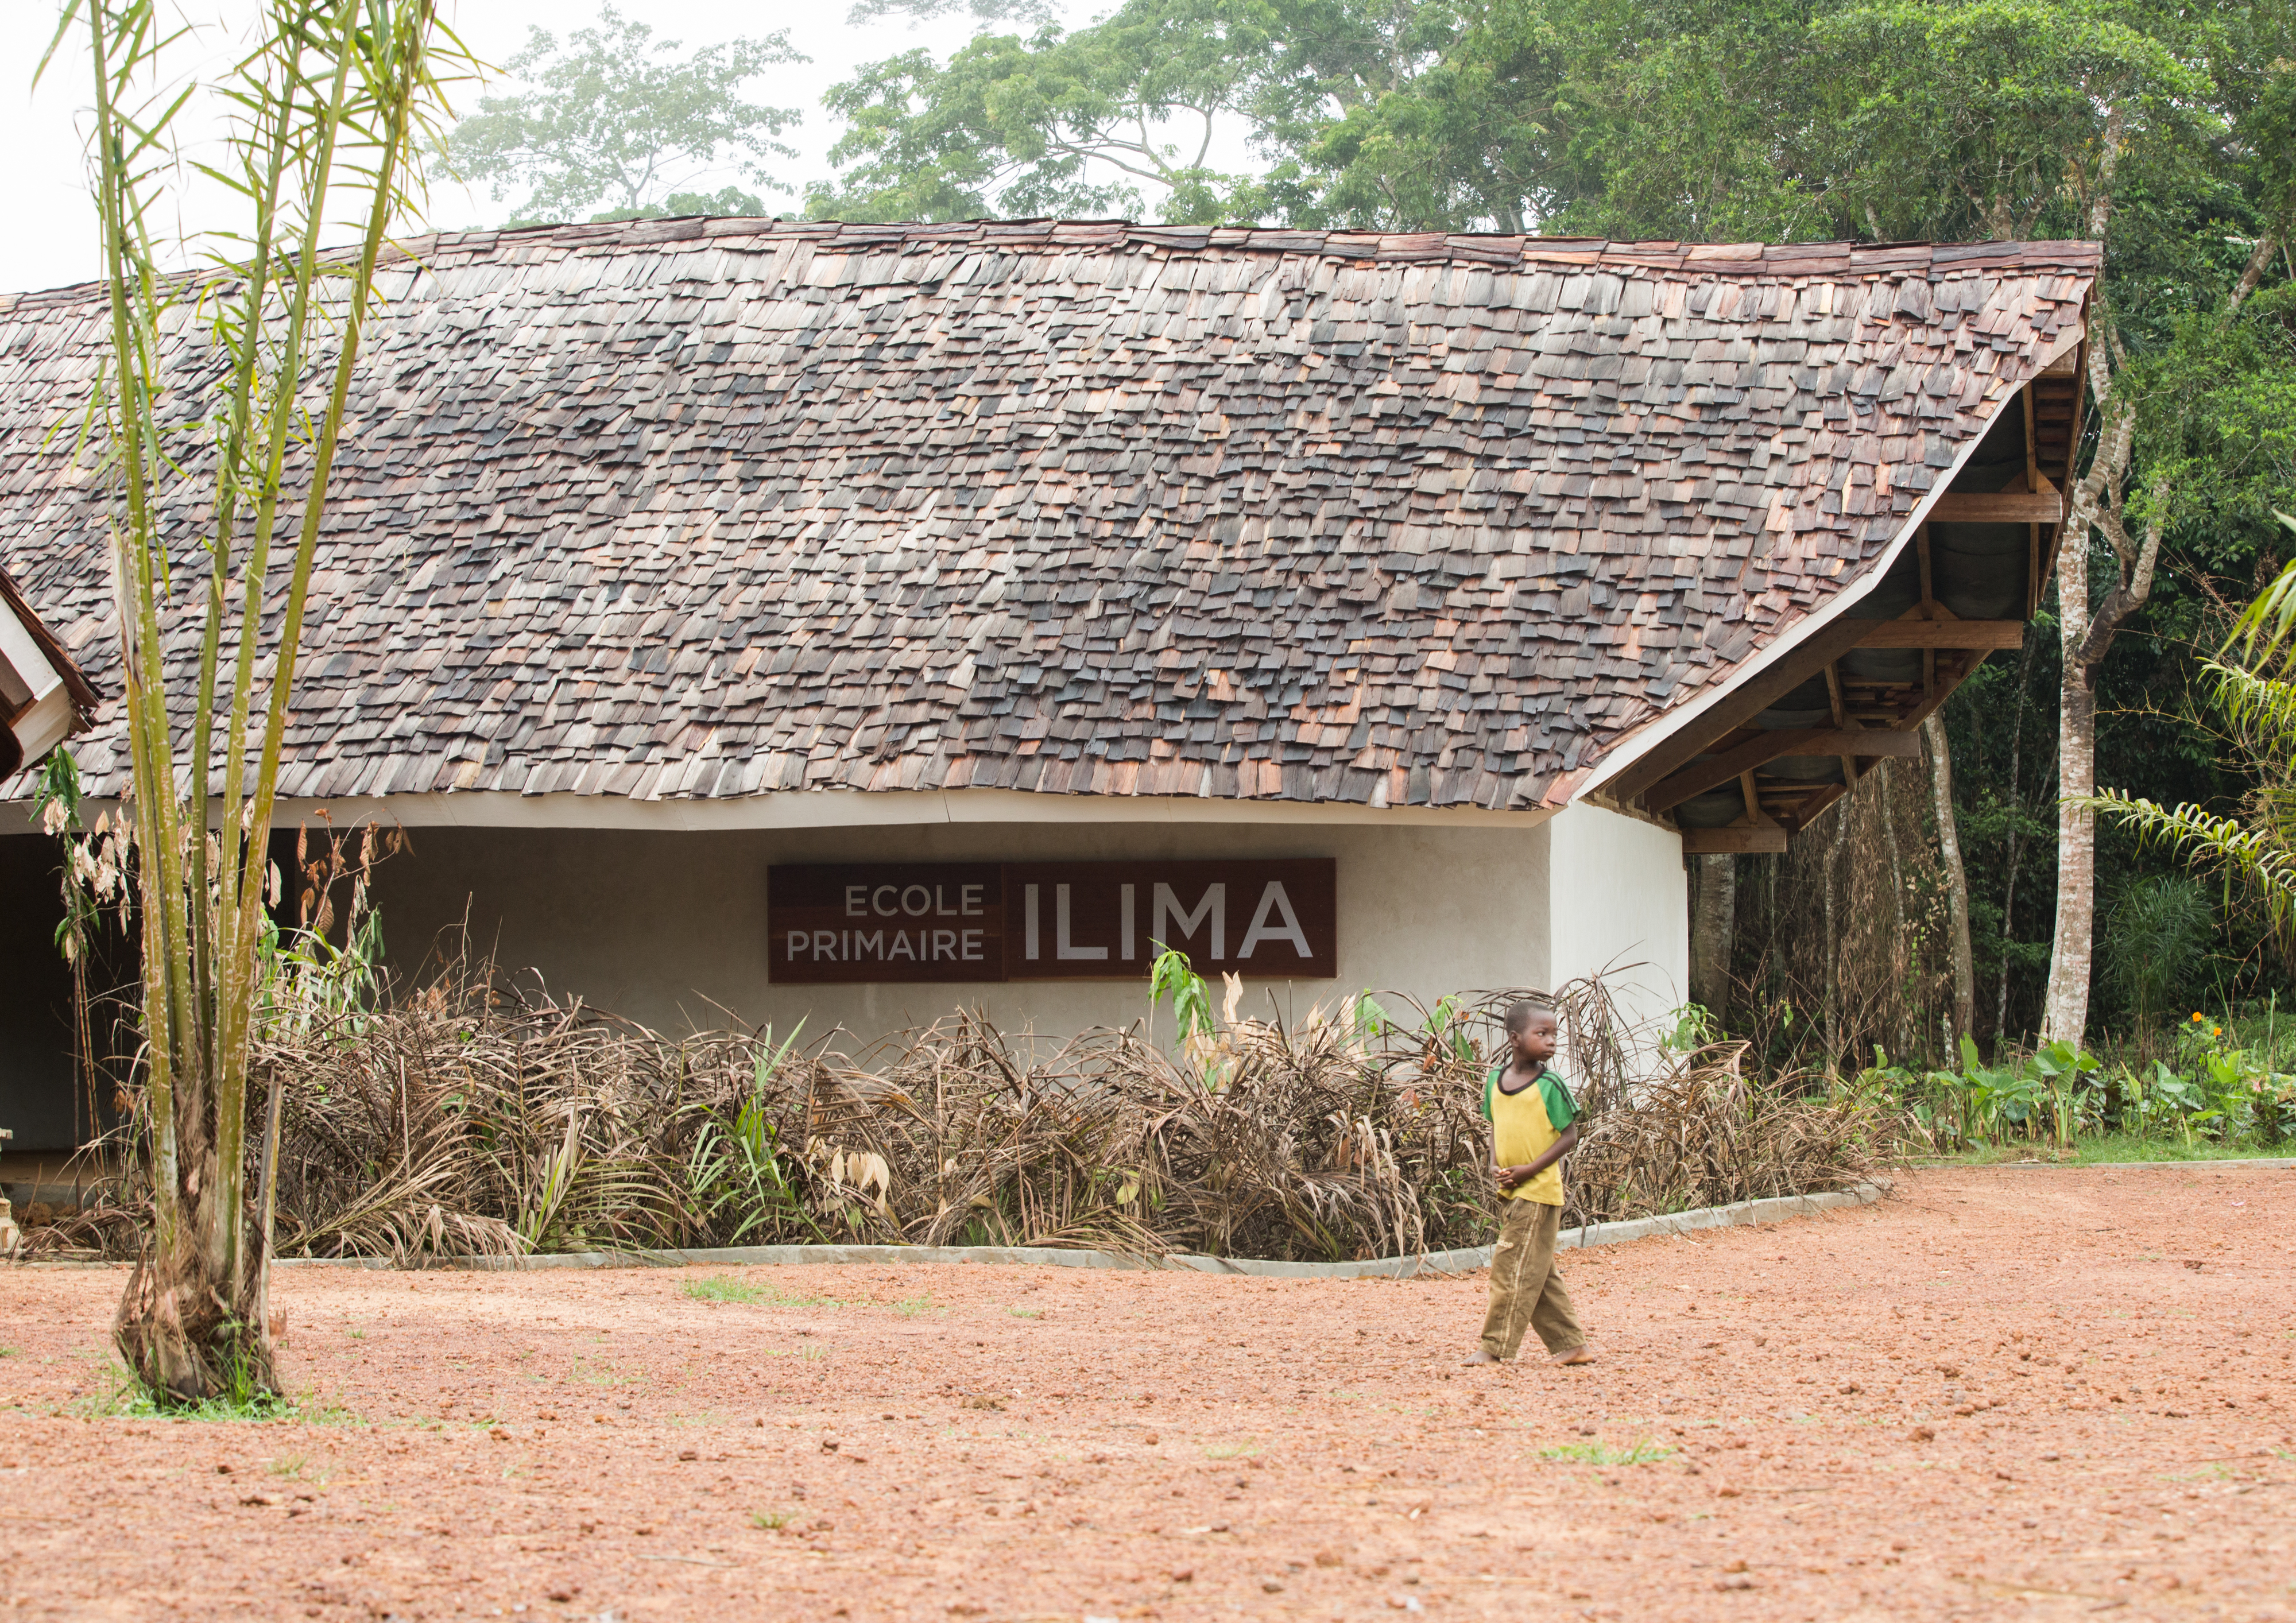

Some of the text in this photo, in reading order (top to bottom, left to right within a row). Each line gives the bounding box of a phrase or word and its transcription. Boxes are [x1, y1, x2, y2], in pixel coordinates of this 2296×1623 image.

[846, 885, 983, 916] ECOLE
[1025, 881, 1314, 960] ILIMA
[787, 929, 984, 961] PRIMAIRE
